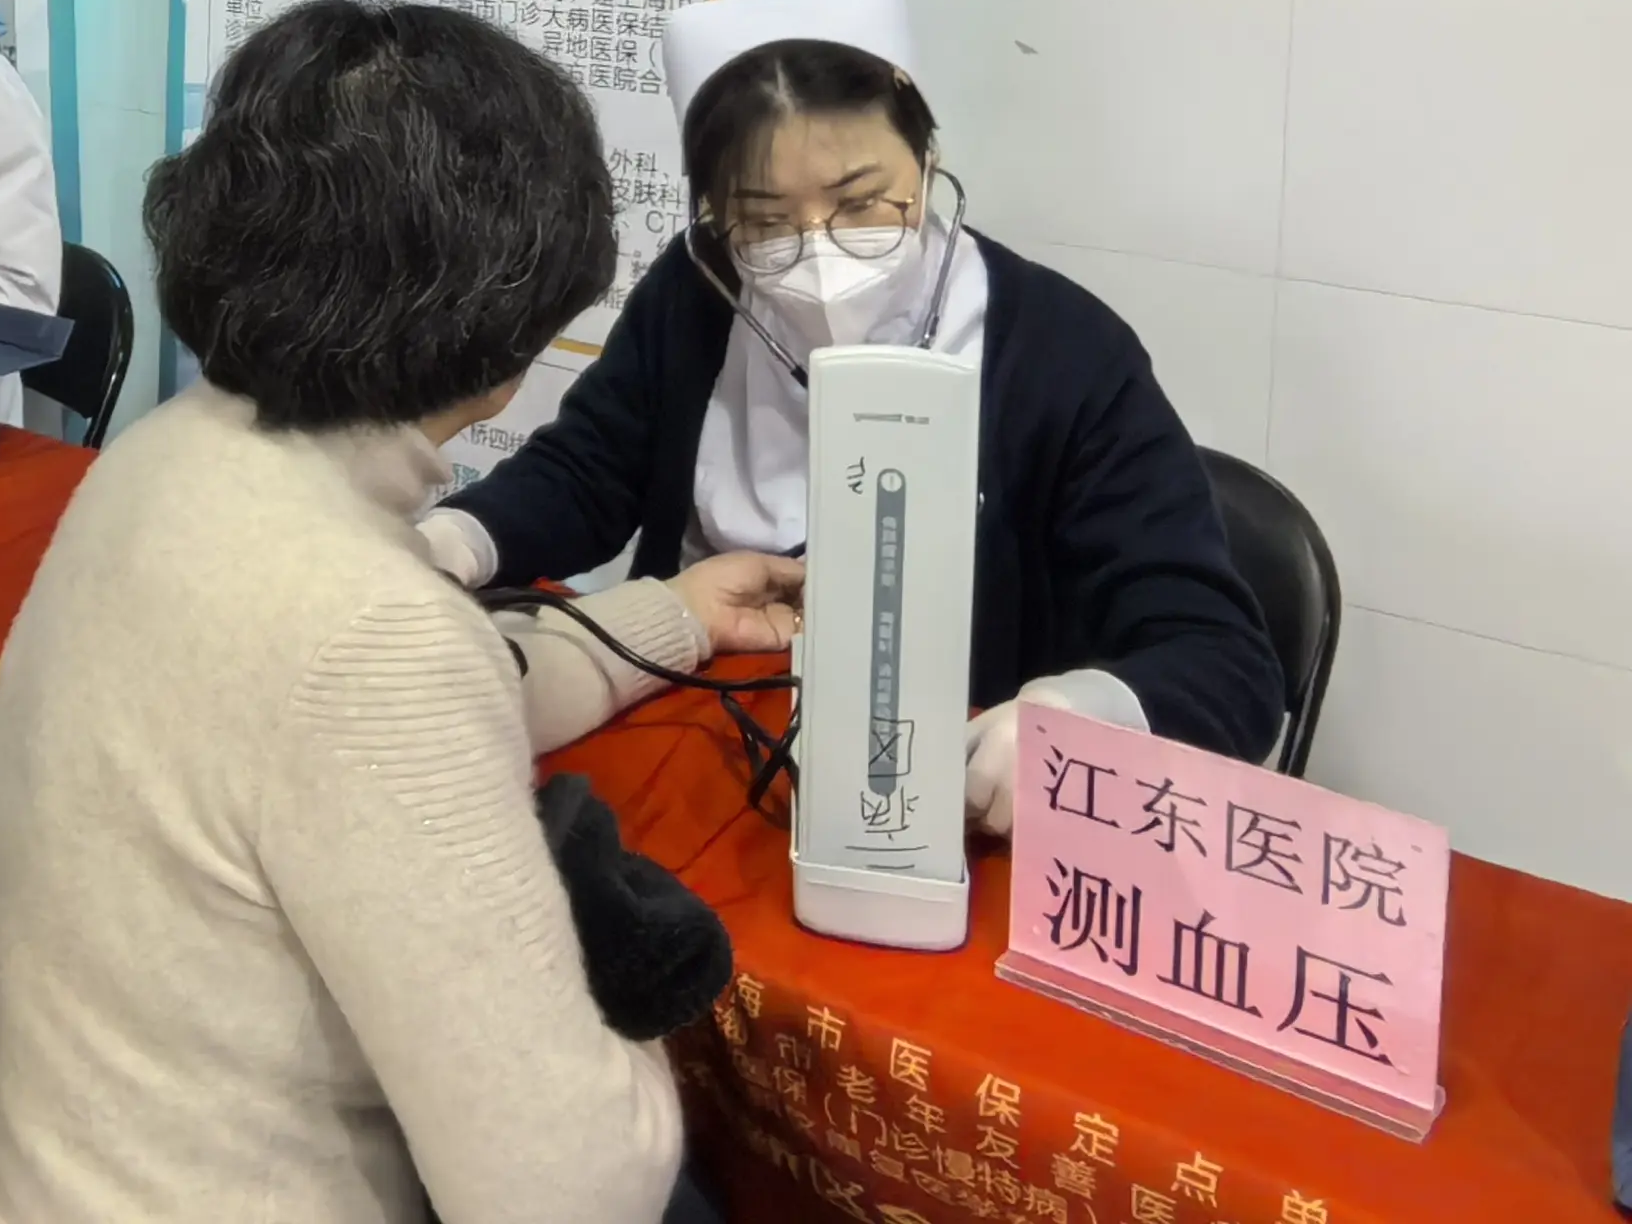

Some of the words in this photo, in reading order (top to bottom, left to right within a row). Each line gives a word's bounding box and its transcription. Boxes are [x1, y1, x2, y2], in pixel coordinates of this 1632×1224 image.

[1041, 744, 1408, 929] 江东医院
[1041, 856, 1397, 1068] 测血压
